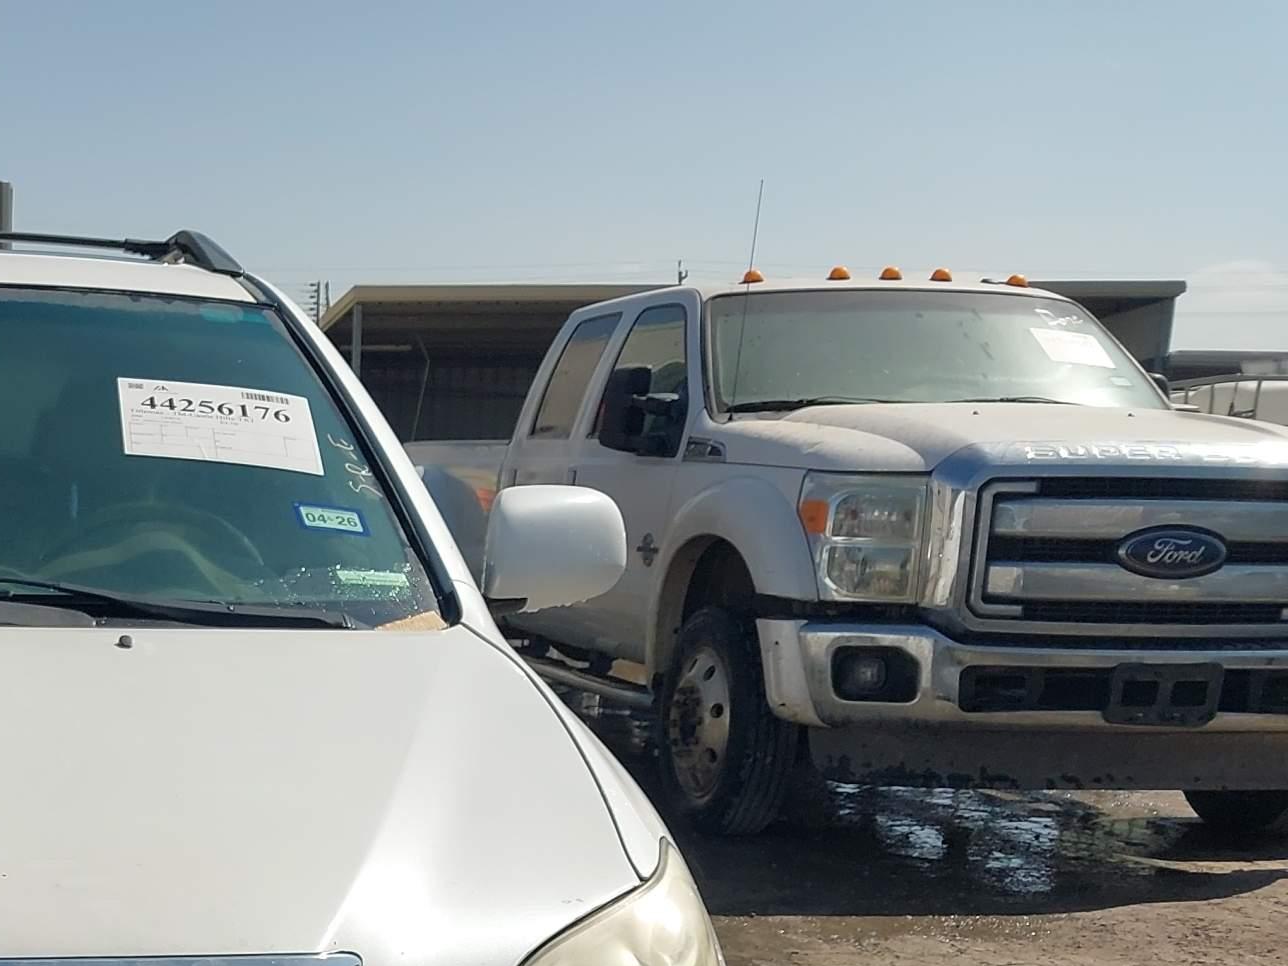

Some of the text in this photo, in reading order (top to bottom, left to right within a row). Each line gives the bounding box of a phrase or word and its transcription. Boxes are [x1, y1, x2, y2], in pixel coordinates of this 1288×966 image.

[140, 396, 291, 424] 44256176
[1024, 445, 1183, 461] SUPER
[1146, 538, 1206, 564] Ford
